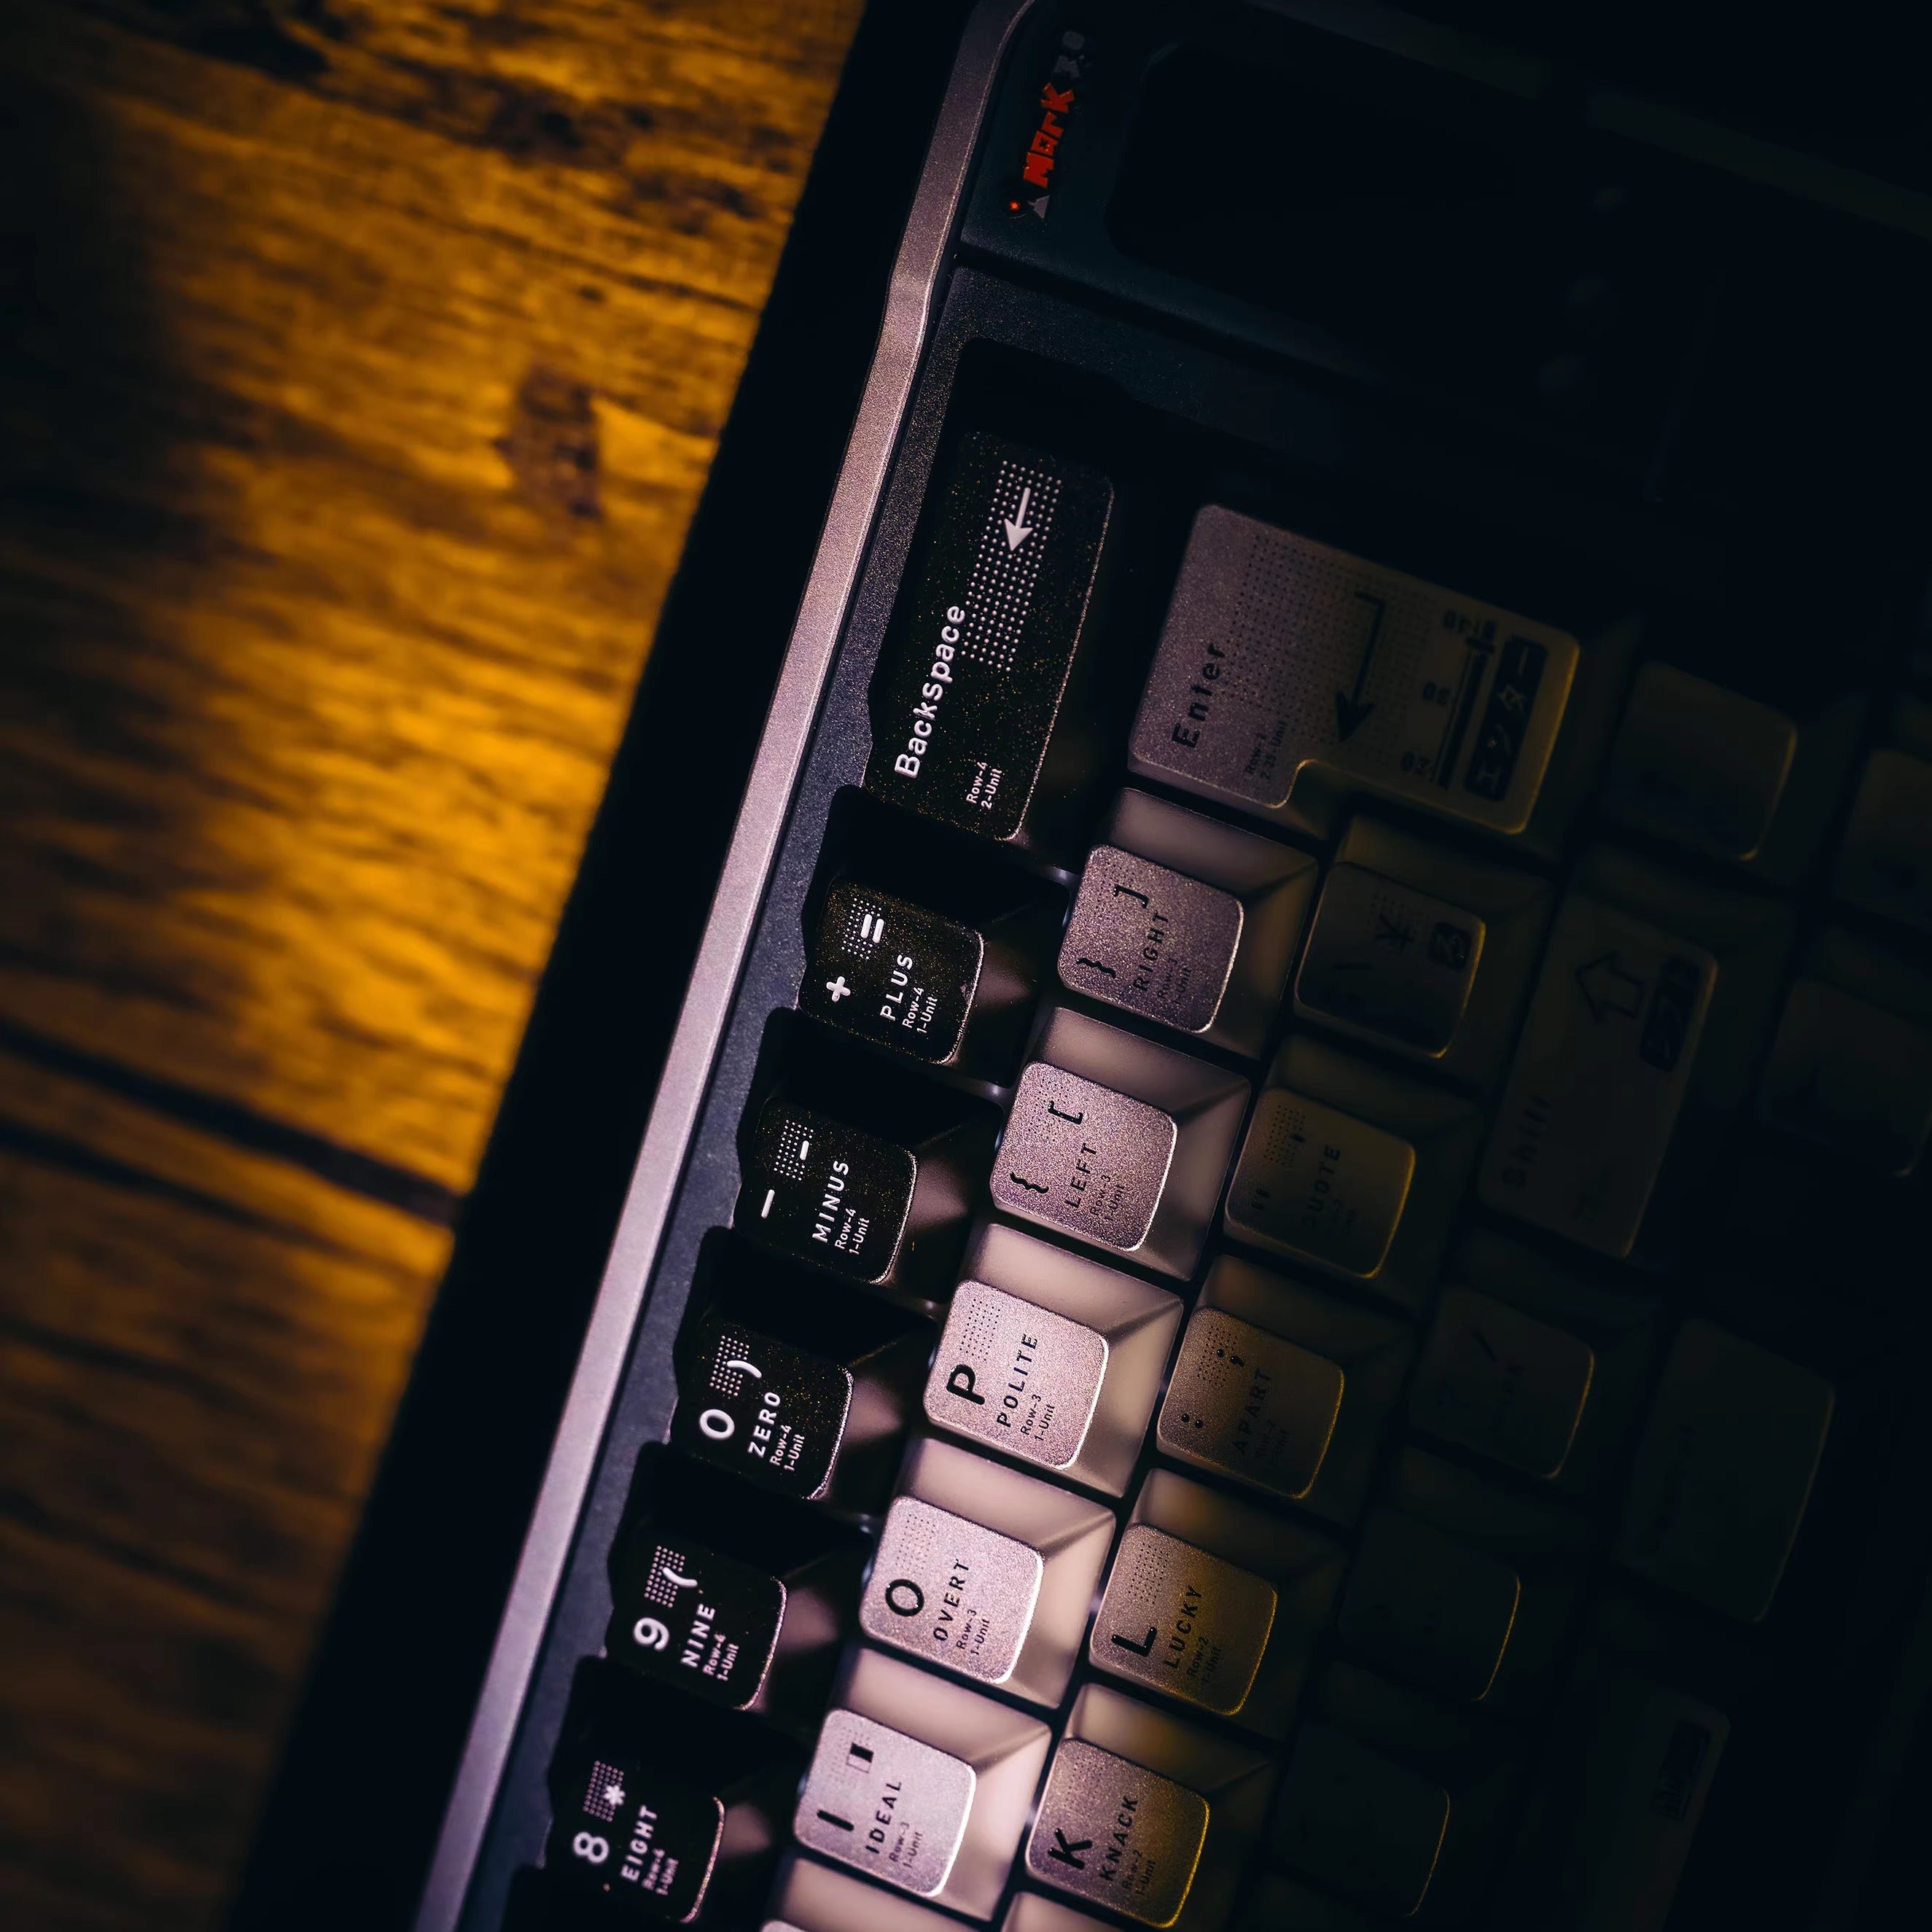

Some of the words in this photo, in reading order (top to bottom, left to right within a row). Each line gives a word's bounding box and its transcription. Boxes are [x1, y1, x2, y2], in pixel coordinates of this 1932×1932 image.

[895, 606, 967, 777] Backspace
[1171, 642, 1226, 749] Enter
[965, 762, 988, 804] Row-4
[981, 768, 1002, 809] 2-Unit
[1131, 911, 1171, 990] RIGHT
[879, 954, 913, 1021] PLUS
[1172, 968, 1191, 1004] 1-Unit
[902, 986, 924, 1029] Row-4
[916, 996, 938, 1033] 1-Unit
[1064, 1143, 1098, 1208] LEFT
[1090, 1175, 1110, 1215] Row-3
[811, 1160, 849, 1243] MINUS
[1105, 1184, 1124, 1220] 1-Unit
[834, 1208, 857, 1250] Row-4
[849, 1218, 870, 1255] 1-Unit
[946, 1364, 986, 1406] P
[996, 1333, 1038, 1428] POLITE
[699, 1409, 735, 1439] 0
[748, 1392, 781, 1457] ZERO
[1020, 1394, 1041, 1435] Row-3
[1035, 1404, 1054, 1440] 1-Unit
[1231, 1368, 1274, 1456] APART
[769, 1425, 792, 1466] Row-4
[784, 1434, 805, 1471] 1-Unit
[884, 1578, 925, 1618] O
[932, 1562, 969, 1642] OVERT
[634, 1617, 669, 1650] 9
[681, 1603, 715, 1667] NINE
[957, 1610, 976, 1649] Row-3
[972, 1619, 989, 1654] 1-Unit
[1110, 1626, 1158, 1659] L
[1164, 1586, 1203, 1669] LUCKY
[717, 1643, 739, 1681] 1-Unit
[1188, 1636, 1208, 1676] Row-2
[817, 1810, 854, 1832] I
[864, 1783, 900, 1855] IDEAL
[1097, 1797, 1138, 1880] KNACK
[573, 1831, 609, 1863] 8
[621, 1805, 657, 1881] EIGHT
[903, 1832, 922, 1867] 1-Unit
[1047, 1828, 1093, 1871] K
[1137, 1859, 1156, 1896] 1-Unit
